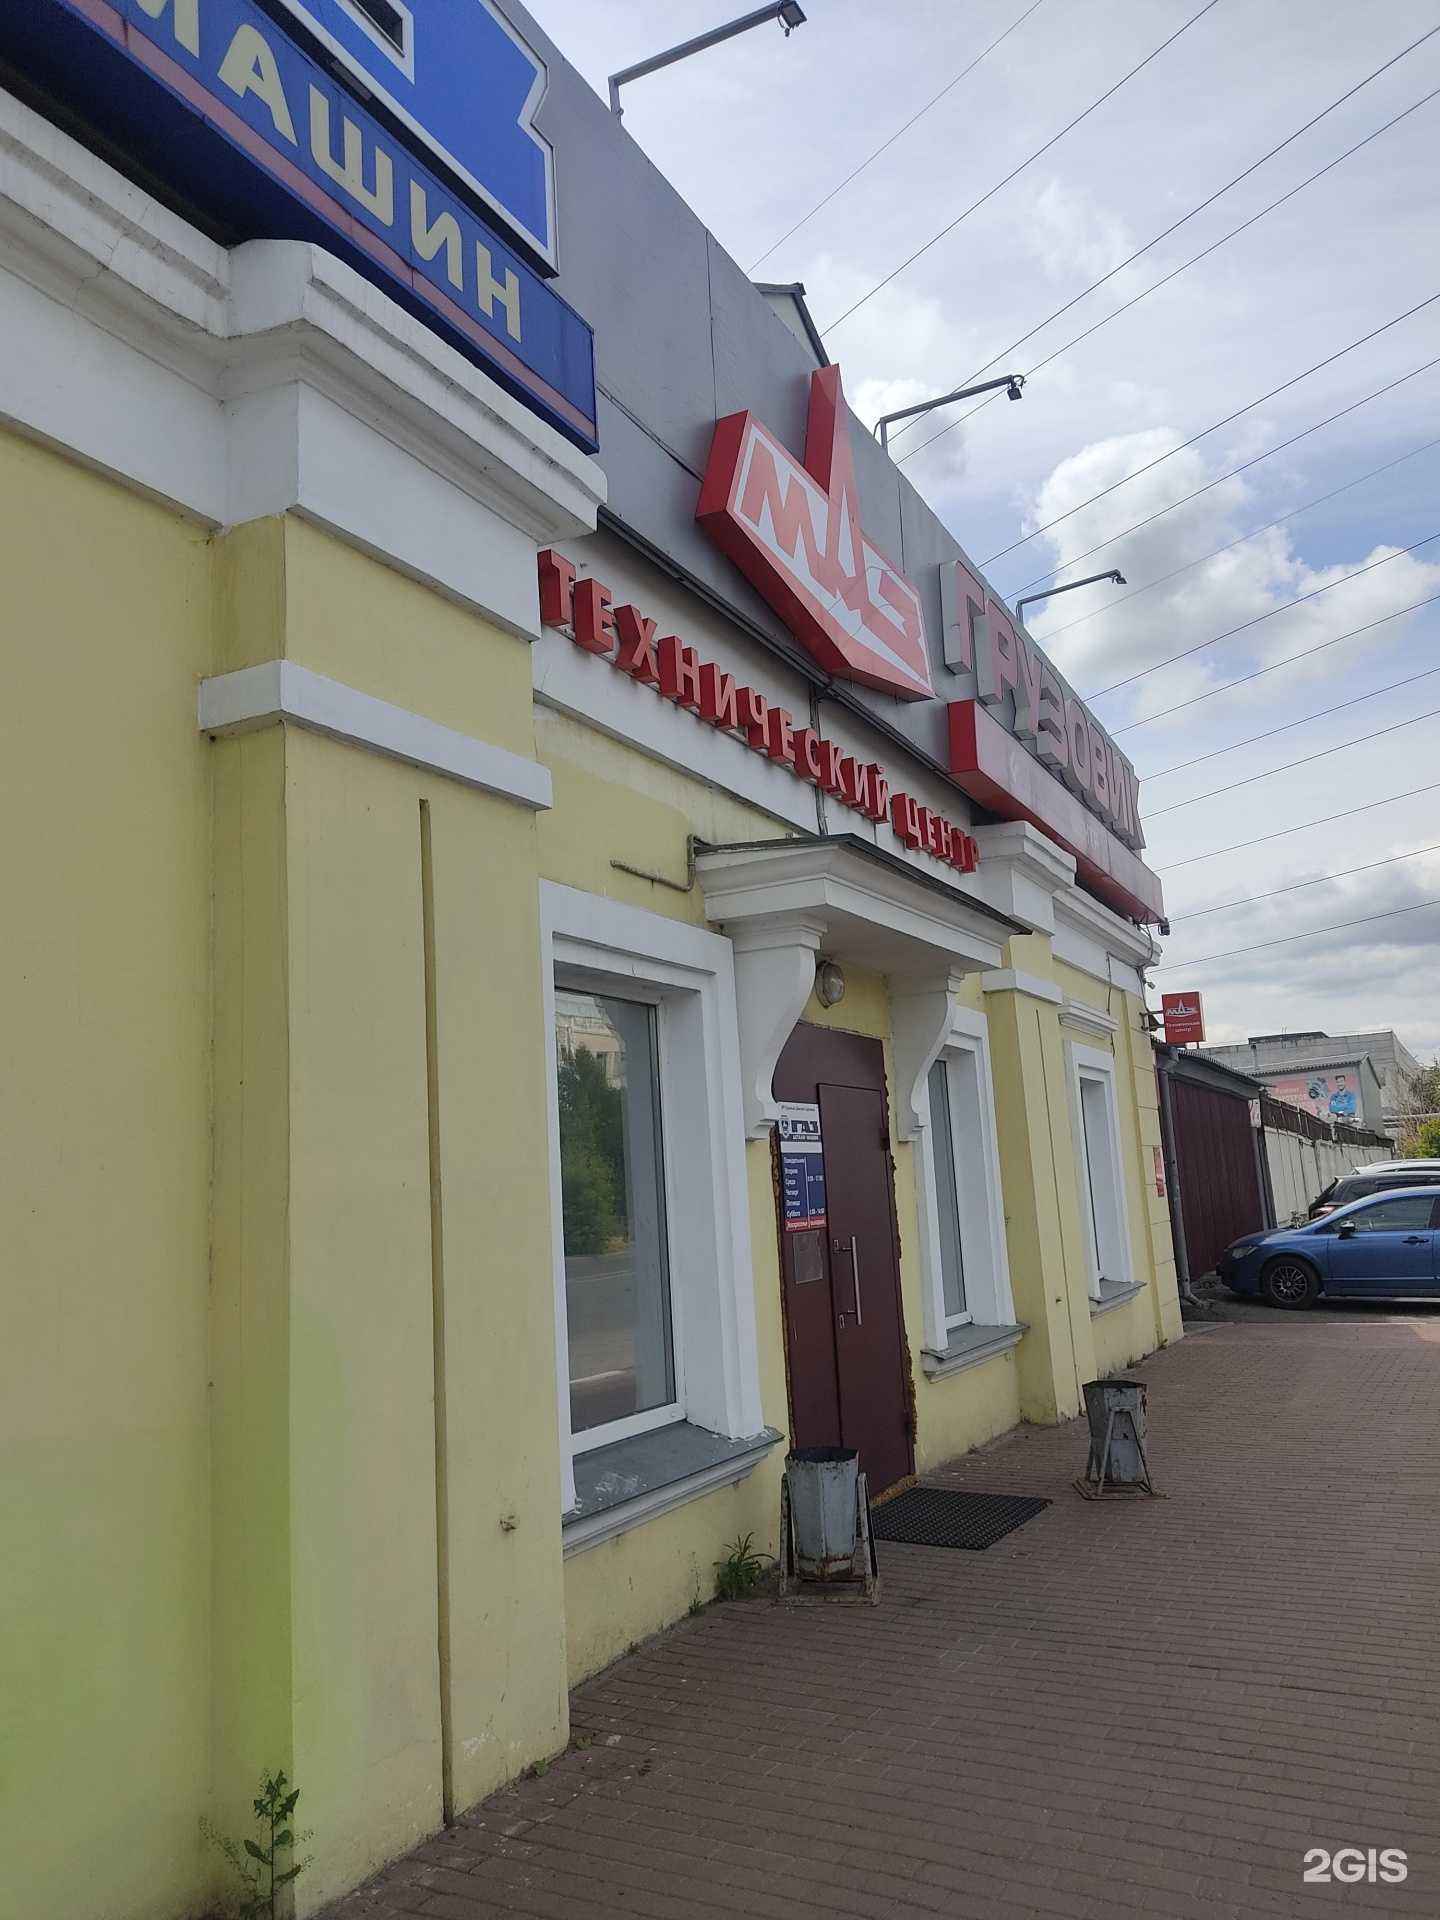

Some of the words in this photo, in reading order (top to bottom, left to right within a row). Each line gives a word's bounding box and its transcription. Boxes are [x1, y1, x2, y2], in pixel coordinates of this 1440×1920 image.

[538, 549, 891, 824] ТЕХНИЧЕСКИЙ
[892, 793, 979, 873] ЦЕНТР
[791, 1120, 819, 1133] ГАЗ
